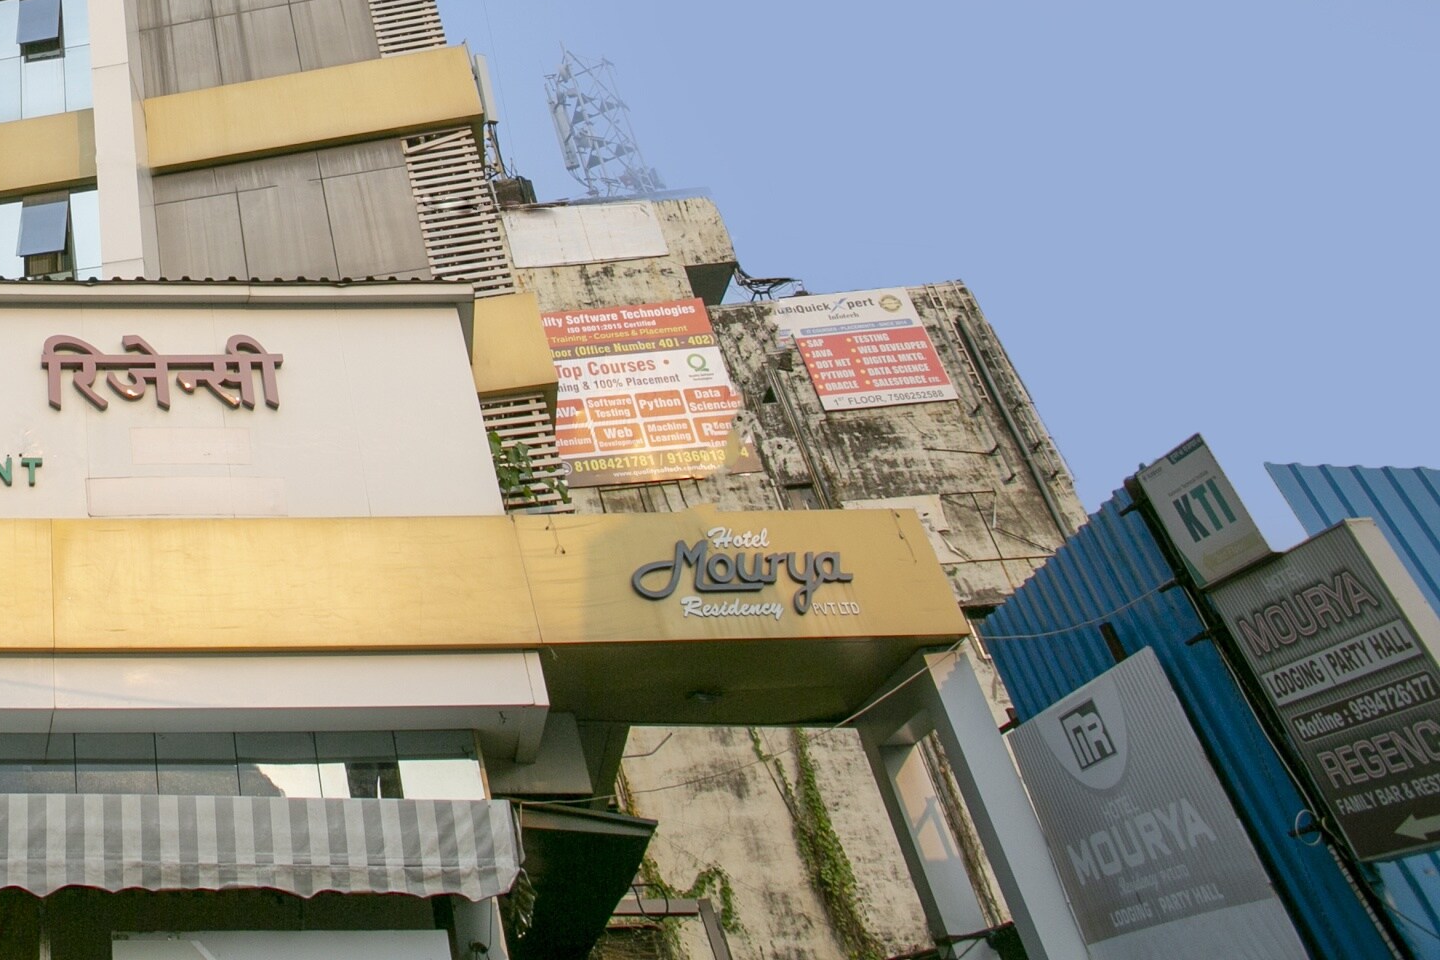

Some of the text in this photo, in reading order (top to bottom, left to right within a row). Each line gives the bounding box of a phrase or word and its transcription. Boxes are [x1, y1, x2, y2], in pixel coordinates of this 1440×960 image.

[565, 311, 619, 325] Software
[620, 304, 696, 321] Technologies
[807, 339, 824, 348] SAP
[853, 333, 890, 344] TESTING
[614, 341, 656, 353] Number
[811, 349, 833, 358] JAVA
[857, 341, 928, 354] WEB DEVELOPER
[816, 358, 851, 369] DOT NET
[862, 355, 897, 365] DIGITAL
[587, 359, 657, 376] Courses
[867, 363, 931, 376] DATA SCIENCE
[594, 378, 624, 389] 100%
[626, 373, 681, 387] Placement
[820, 369, 856, 380] PYTHON
[825, 380, 860, 391] ORACLE
[872, 376, 927, 387] SALESFORCE
[694, 388, 721, 399] Data
[888, 390, 945, 401] 7506252588
[587, 396, 633, 408] Software
[638, 397, 682, 411] Python
[595, 408, 631, 419] Testing
[603, 426, 634, 439] Web
[647, 422, 688, 433] Machine
[649, 432, 692, 444] Learning
[574, 453, 655, 472] 8108421781
[1172, 477, 1237, 543] KTI
[707, 526, 770, 548] Hotel
[631, 540, 854, 615] Mourya
[680, 596, 785, 620] Residency
[1238, 571, 1379, 657] MOURYA
[1266, 626, 1414, 700] LODGING PARTY HALL
[1294, 712, 1345, 739] Hotline
[1348, 675, 1437, 722] 9594726177
[1317, 719, 1440, 789] REGENC
[1335, 791, 1378, 816] FAMILY
[1376, 785, 1406, 806] BAR
[1066, 798, 1217, 886] MOURYA
[1109, 883, 1225, 927] LODGING PARTY HALL
